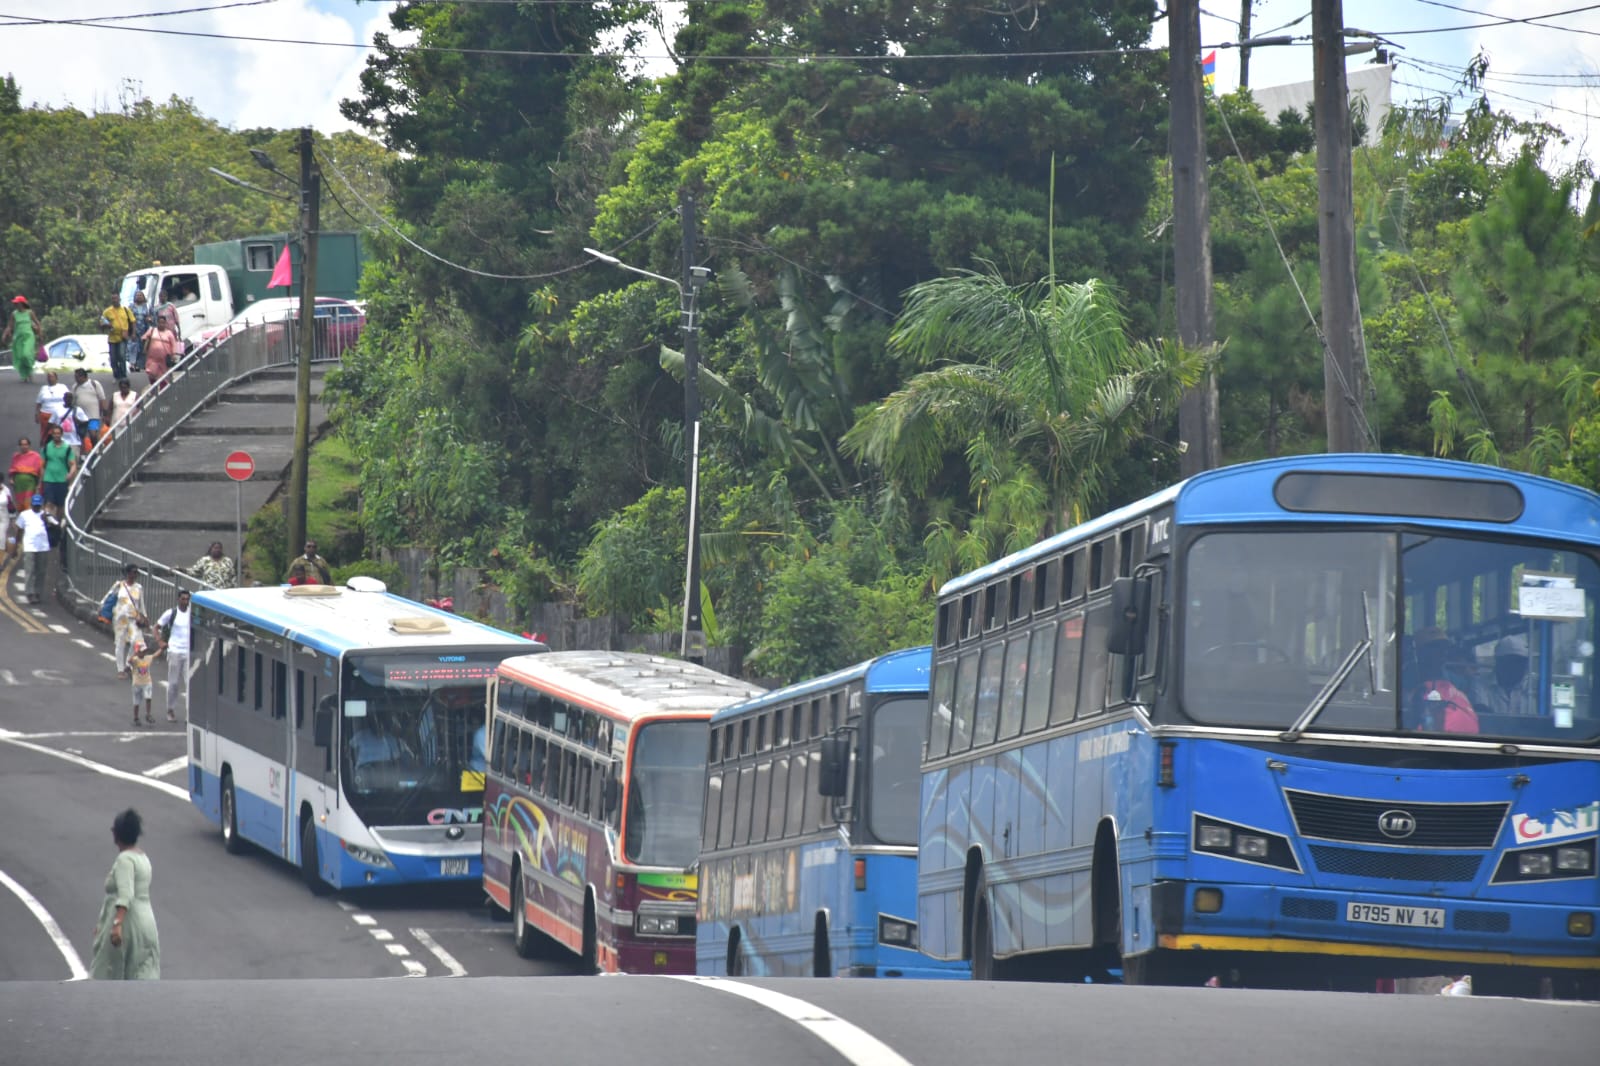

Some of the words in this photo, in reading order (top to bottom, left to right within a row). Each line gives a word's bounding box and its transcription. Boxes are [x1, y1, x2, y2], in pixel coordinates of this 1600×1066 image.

[427, 808, 483, 825] CNT
[1352, 904, 1390, 922] 8795
[1396, 907, 1415, 924] NV
[1422, 909, 1439, 926] 14
